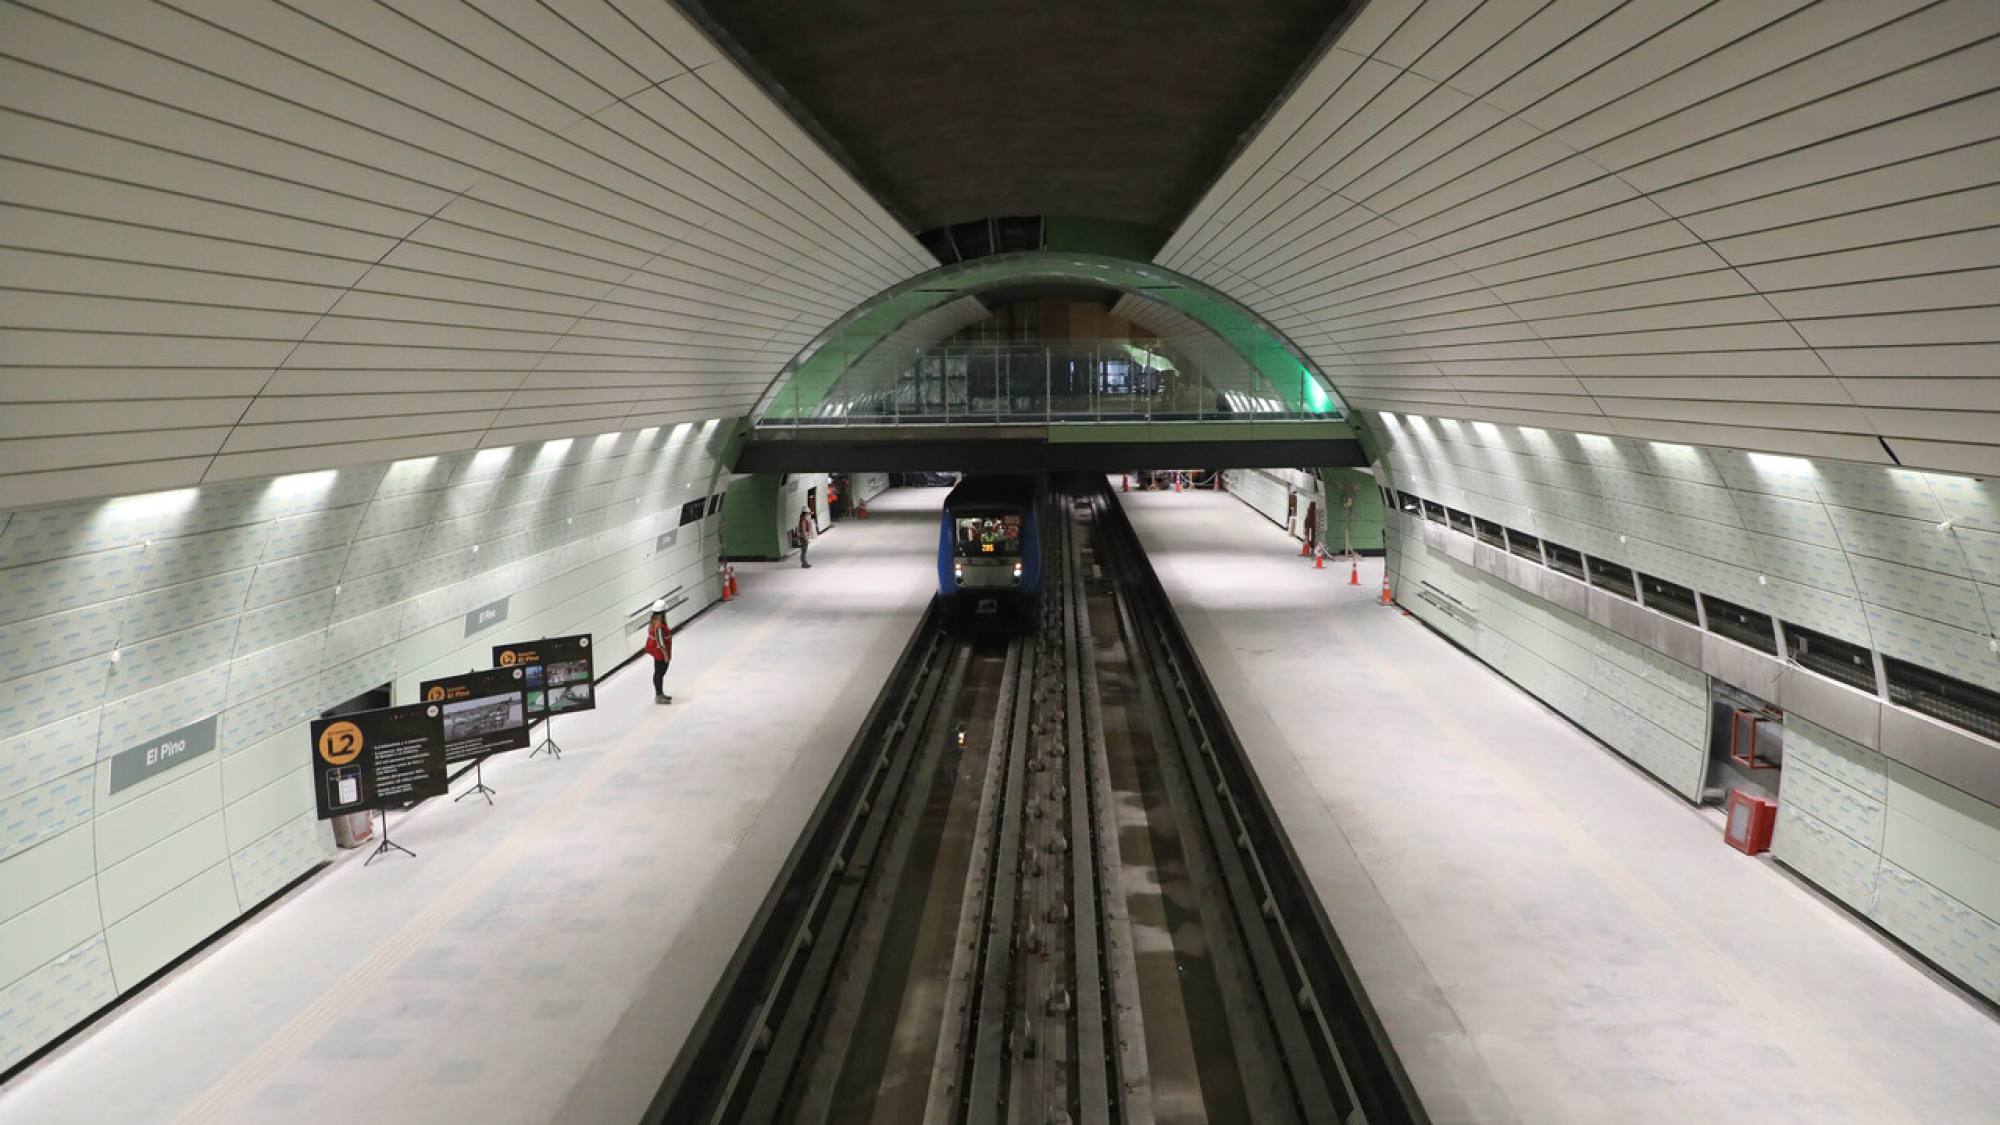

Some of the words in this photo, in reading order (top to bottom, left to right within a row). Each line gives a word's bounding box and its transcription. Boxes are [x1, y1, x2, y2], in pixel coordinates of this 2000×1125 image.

[146, 747, 159, 766] El
[160, 740, 186, 760] Pino
[327, 733, 354, 757] L2
